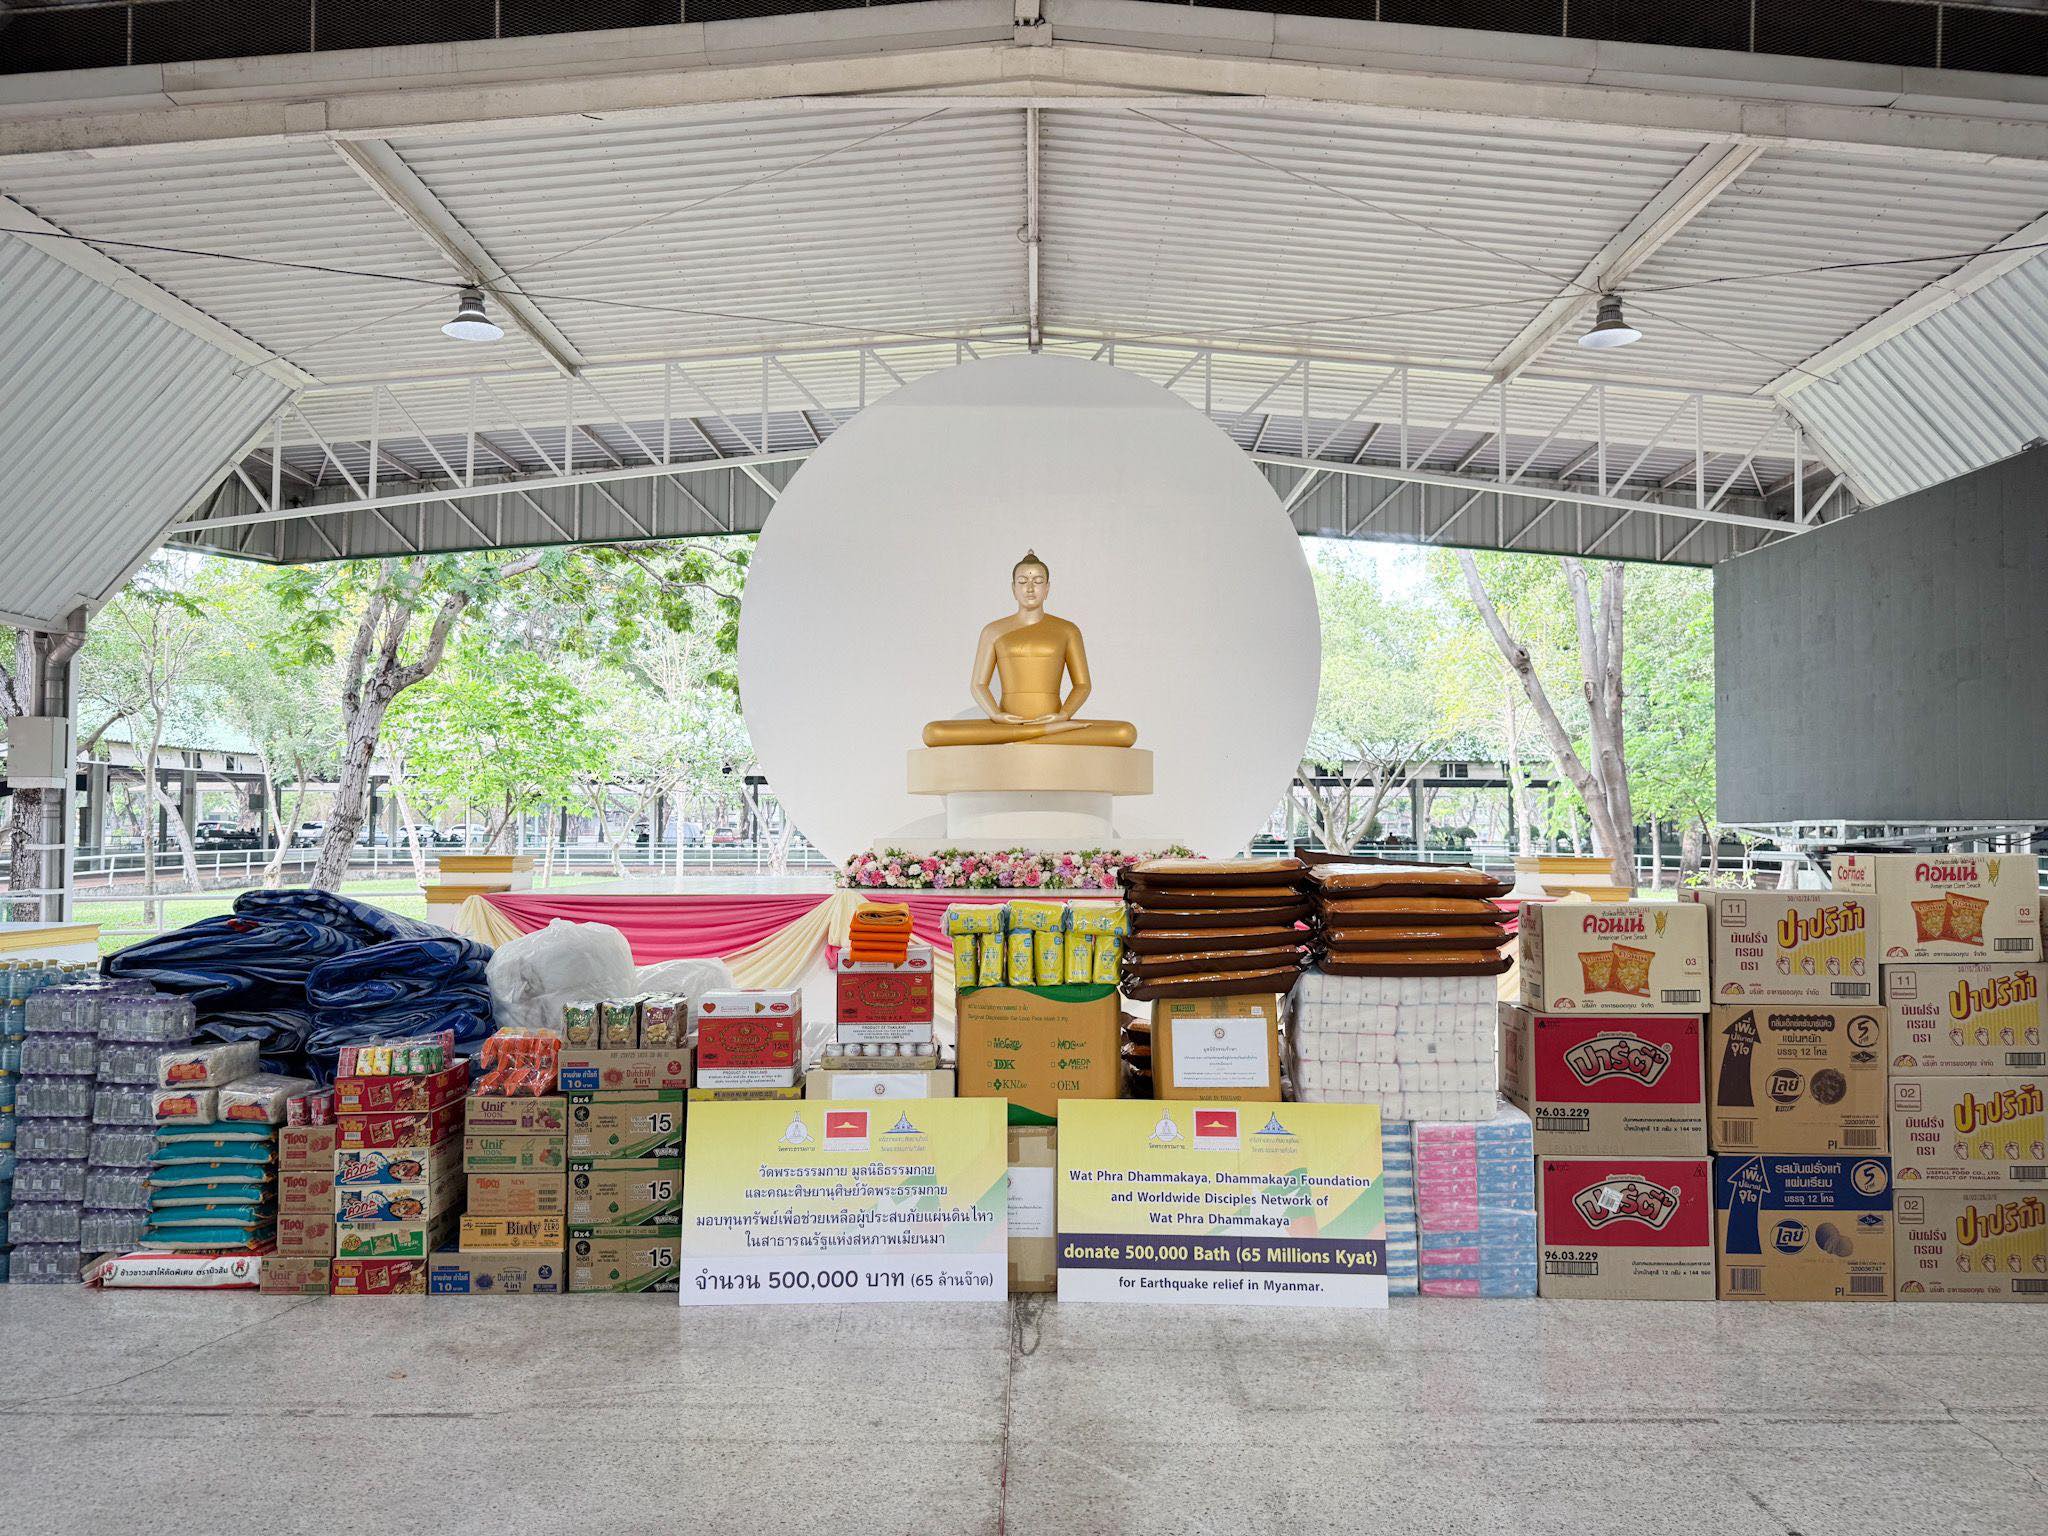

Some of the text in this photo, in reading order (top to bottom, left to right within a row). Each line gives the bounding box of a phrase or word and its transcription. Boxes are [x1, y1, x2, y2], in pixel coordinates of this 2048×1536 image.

[1915, 861, 1978, 882] คอนเน่
[1728, 904, 1740, 914] 11
[2019, 908, 2030, 916] 03
[1583, 914, 1645, 933] คอนเน่
[1777, 901, 1865, 949] ปาปริก้า
[1731, 931, 1768, 944] มันฝรั่ง
[1735, 947, 1764, 957] กรอบ
[1686, 958, 1696, 966] 03
[1740, 961, 1759, 971] ตรา
[1897, 976, 1910, 985] 11
[1949, 970, 2037, 1020] ปาปริก้า
[1901, 1002, 1940, 1015] มันฝรั่ง
[1734, 1017, 1756, 1036] เพิ่ม
[1858, 1020, 1869, 1037] 5
[1907, 1019, 1936, 1029] กรอบ
[1782, 1033, 1821, 1043] แผ่นหยัก
[1912, 1034, 1931, 1043] ตรา
[1731, 1043, 1749, 1056] จุใจ
[1777, 1047, 1827, 1058] บรรจุ 12 โหล
[994, 1059, 1016, 1070] DK
[1574, 1040, 1665, 1078] ปาร์ตี้
[568, 1080, 581, 1088] 10
[1057, 1081, 1080, 1090] OEM
[1772, 1074, 1799, 1094] เลย์
[1900, 1088, 1915, 1098] 02
[481, 1101, 506, 1111] Unif
[1536, 1108, 1589, 1117] 96.03.229
[1954, 1084, 2044, 1133] ปาปริก้า
[649, 1114, 671, 1132] 15
[1905, 1115, 1944, 1128] มันฝรั่ง
[1910, 1132, 1940, 1142] กรอบ
[480, 1139, 505, 1149] Unif
[1916, 1146, 1935, 1155] ตรา
[759, 1161, 935, 1180] วัดพระธรรมกาย มูลนิธิธรรมกาย
[1742, 1166, 1763, 1182] เพิ่ม
[1775, 1161, 1841, 1174] รสมันฝรั่งแท้
[1070, 1171, 1370, 1187] Wat Phra Dhammakaya, Dhammakaya Foundation
[1785, 1177, 1833, 1187] แผ่นเรียบ
[1864, 1167, 1876, 1185] 5
[649, 1181, 671, 1200] 15
[745, 1182, 948, 1200] และคณะศิษยานุศิษย์วัดพระธรรมกาย
[1739, 1190, 1757, 1204] จุใจ
[1111, 1191, 1328, 1207] and Worldwide Disciples Network of
[1582, 1183, 1673, 1221] ปร์ตี้
[1784, 1194, 1805, 1204] บรรจุ
[1821, 1193, 1834, 1203] โหล
[1904, 1201, 1919, 1210] 02
[696, 1205, 994, 1229] มอบทุนทรัพย์เพื่อช่วยเหลือผู้ประสบภัยแผ่นดินไหว
[1150, 1213, 1290, 1228] Wat Phra Dhammakaya
[1956, 1197, 2045, 1246] ปาปริก้า
[506, 1221, 541, 1239] Birdy
[544, 1223, 559, 1231] ZERO
[745, 1230, 945, 1250] ในสาธารณรัฐแห่งสหภาพเมียนมา
[1776, 1226, 1804, 1245] เลย์
[1909, 1228, 1947, 1240] มันฝรั่ง
[1064, 1244, 1378, 1267] donate 500,000 Bath (65 Millions Kyat)
[1545, 1251, 1598, 1260] 96.03.229
[1914, 1245, 1942, 1254] กรอบ
[649, 1249, 672, 1266] 15
[1920, 1260, 1938, 1268] ตรา
[696, 1269, 993, 1291] จำนวน 500,000 บาท (65 ล้านจ๊าด)
[1119, 1277, 1324, 1294] for Earthquake relief in Myanmar.
[438, 1283, 452, 1291] 10
